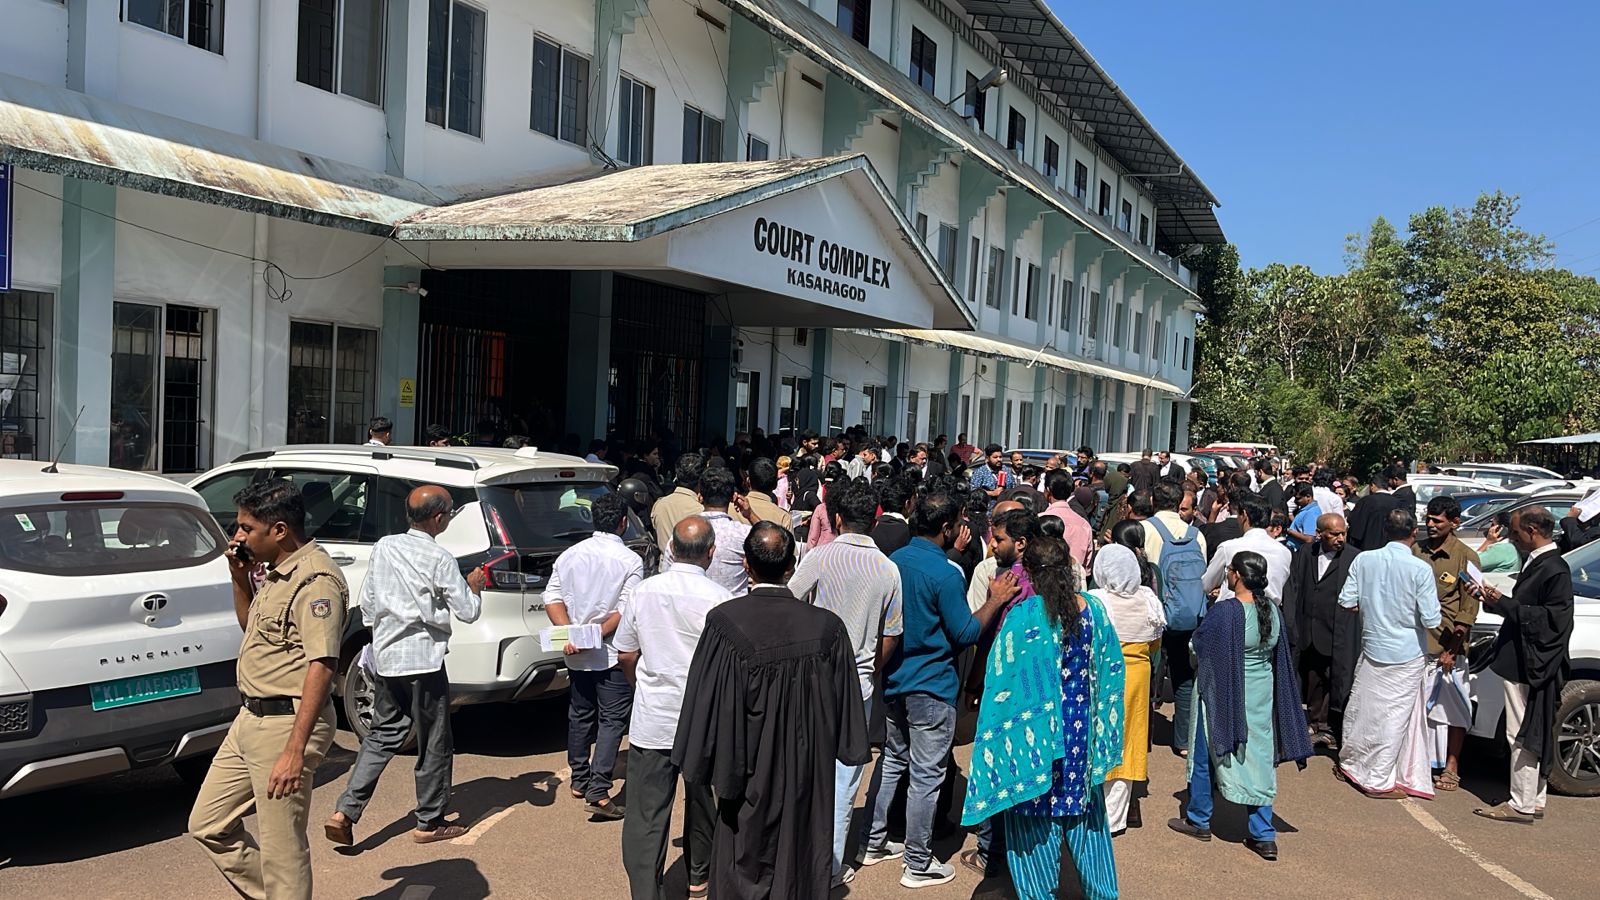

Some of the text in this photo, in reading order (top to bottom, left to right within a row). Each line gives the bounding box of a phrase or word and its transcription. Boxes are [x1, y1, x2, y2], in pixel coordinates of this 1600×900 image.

[754, 217, 891, 288] COURT COMPLEX
[787, 268, 866, 302] KASARAGOD
